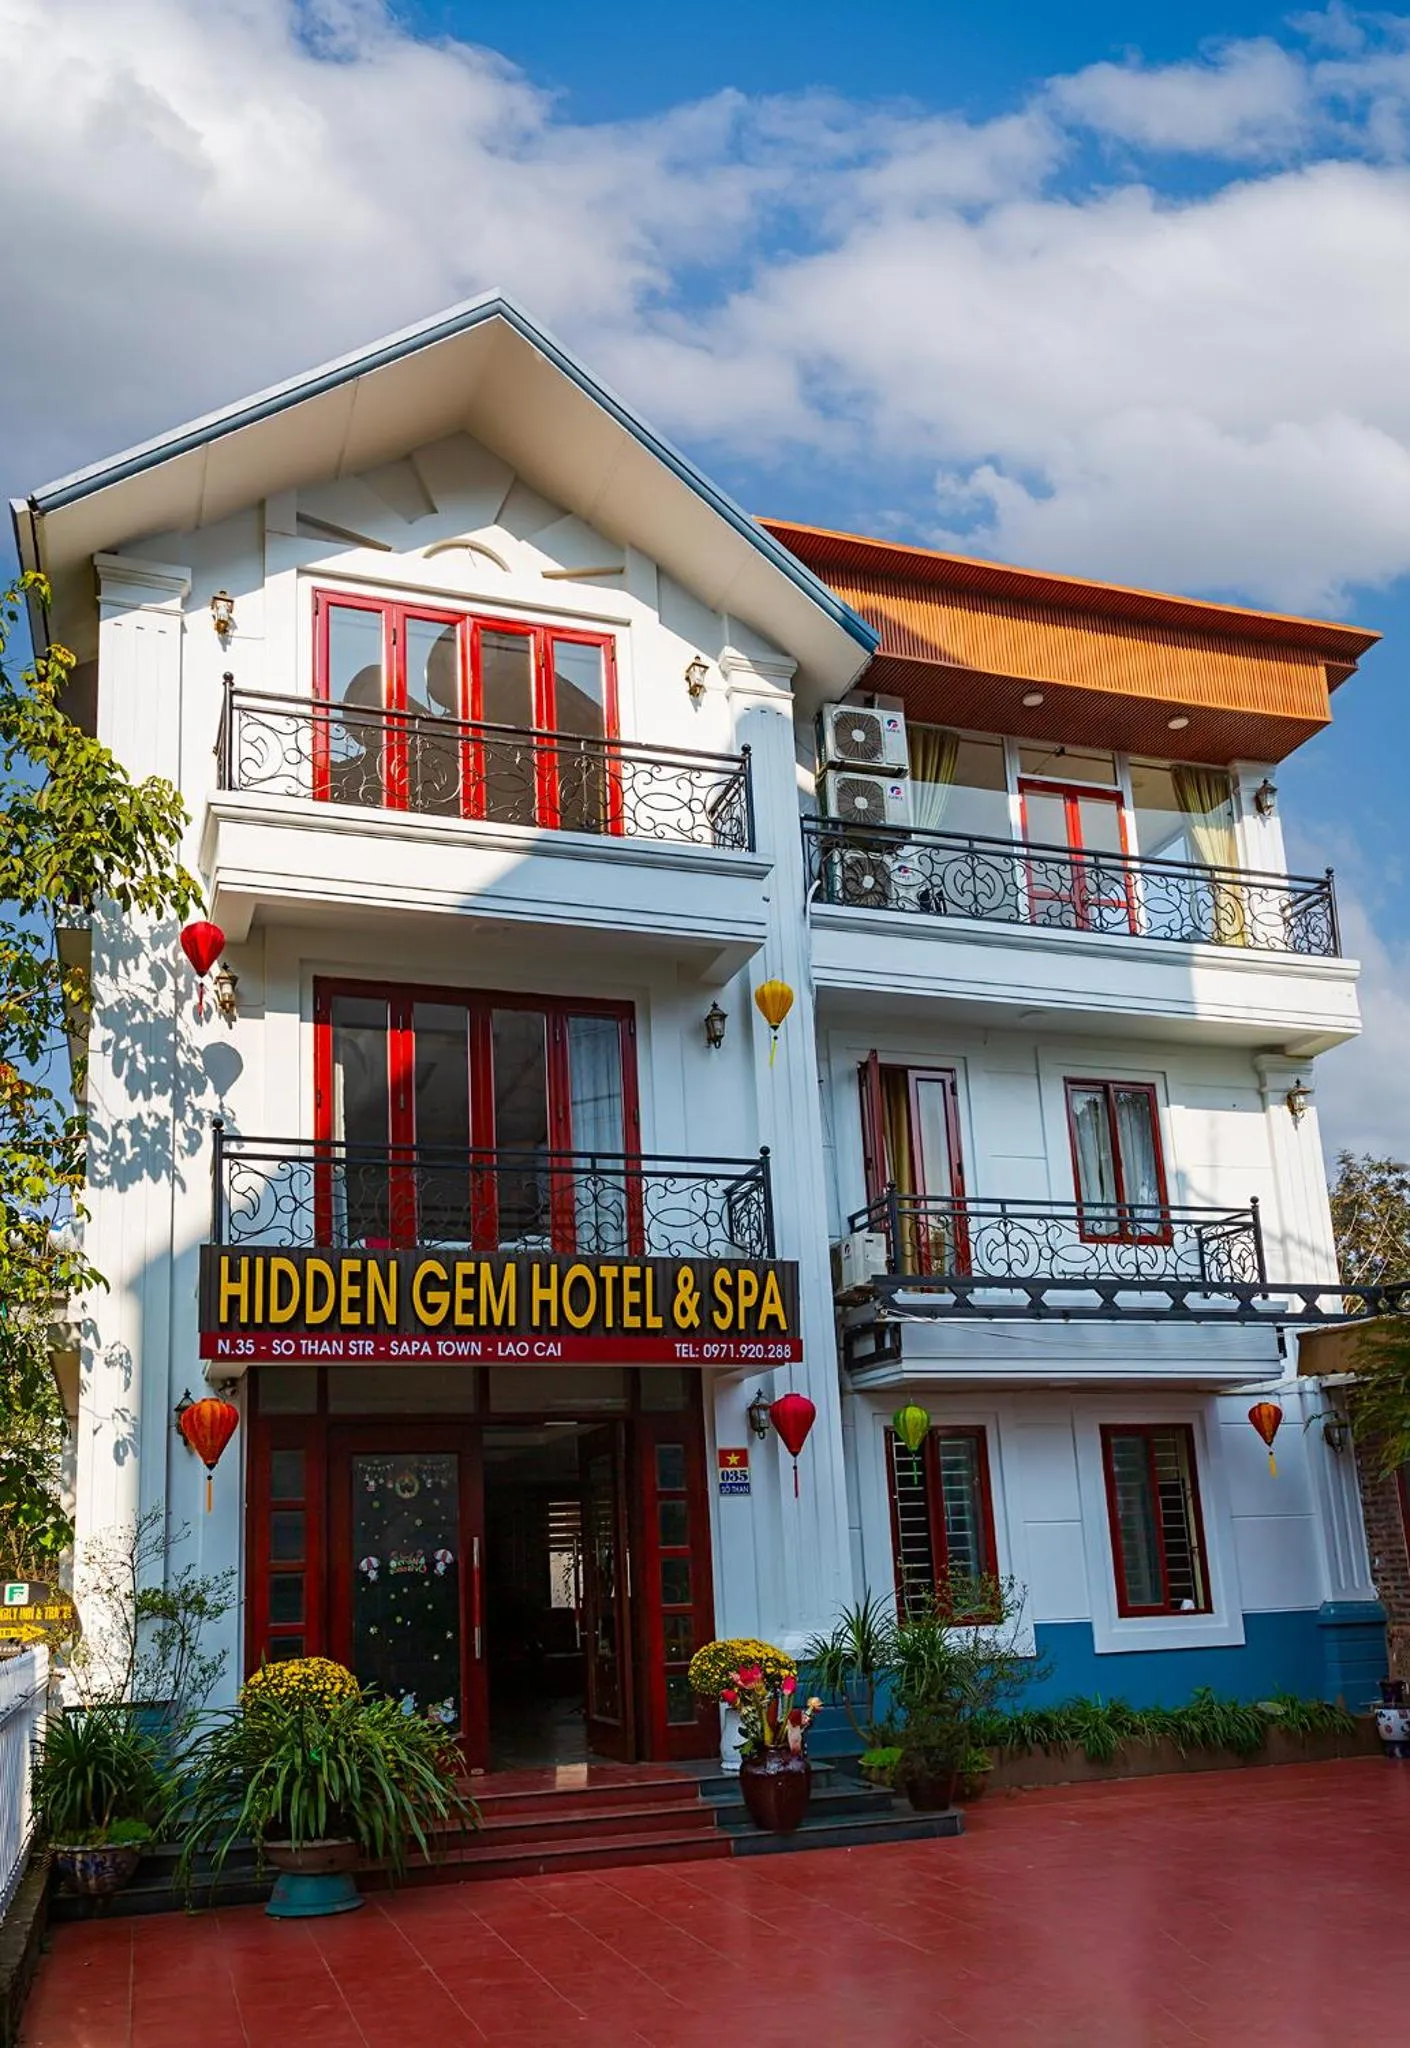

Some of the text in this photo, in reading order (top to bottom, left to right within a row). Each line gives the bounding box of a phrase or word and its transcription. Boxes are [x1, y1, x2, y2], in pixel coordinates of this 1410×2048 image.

[219, 1256, 787, 1330] HIDDEN GEM HOTEL & SPA
[217, 1339, 255, 1355] N.35
[272, 1340, 295, 1355] SO
[300, 1340, 343, 1355] THAN
[348, 1340, 375, 1355] STR
[390, 1341, 432, 1355] SAPA
[437, 1342, 481, 1356] TOWN
[498, 1342, 529, 1356] LAO
[534, 1342, 561, 1356] CAI
[675, 1344, 792, 1358] TEL: 0971.920.288
[721, 1470, 749, 1482] 035
[8, 1586, 24, 1602] F
